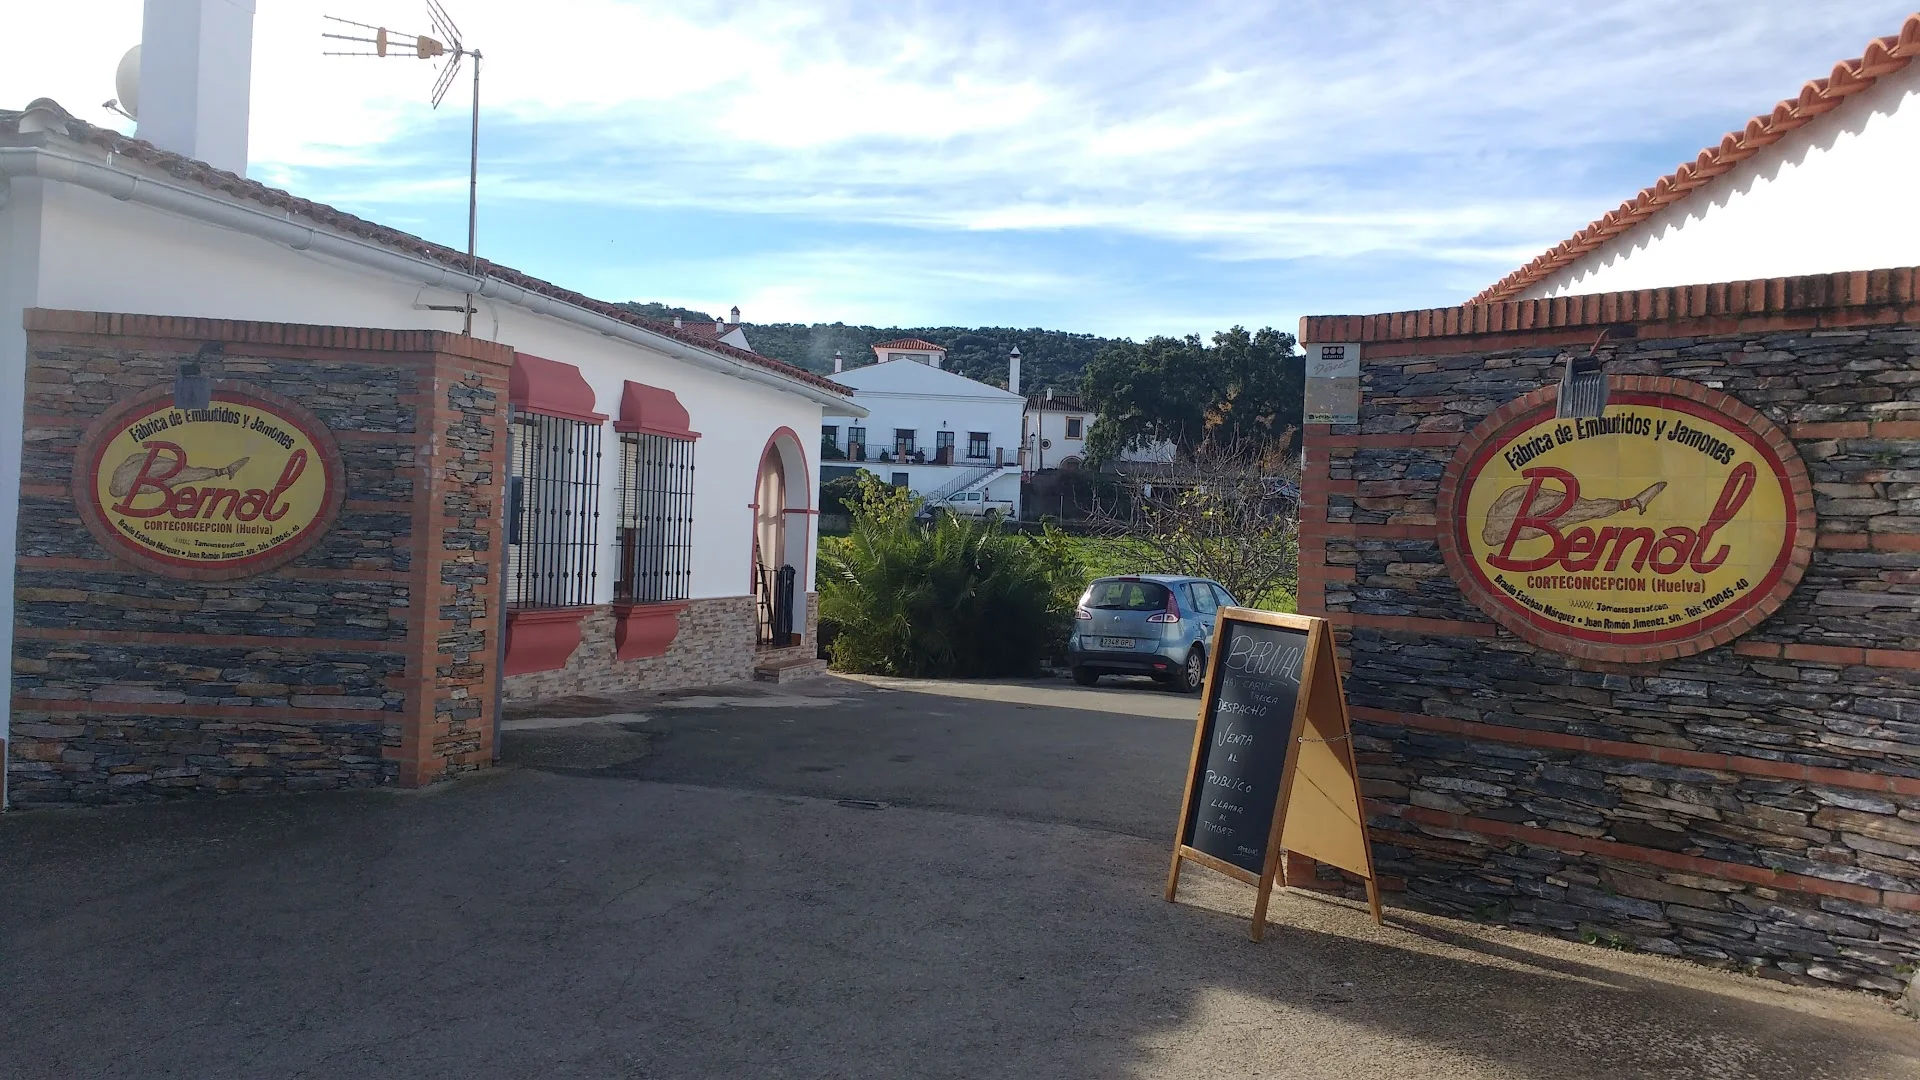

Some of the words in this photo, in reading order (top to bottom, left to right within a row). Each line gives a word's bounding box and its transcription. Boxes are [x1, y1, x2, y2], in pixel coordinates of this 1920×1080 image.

[128, 418, 168, 443] Fábrica
[168, 411, 183, 427] de
[184, 407, 240, 424] Embutidos
[242, 414, 250, 429] y
[250, 416, 295, 450] Jamones
[1503, 436, 1555, 471] Fábrica
[1554, 423, 1573, 445] de
[1575, 412, 1651, 440] Embutidos
[1654, 420, 1667, 441] y
[1667, 420, 1735, 465] Jamones
[111, 441, 308, 522] Bernal
[144, 520, 232, 533] CORTECONCEPCION
[236, 524, 273, 535] (Huelva)
[1486, 461, 1757, 575] Bernal
[134, 531, 156, 547] Esteban
[186, 550, 200, 559] Juan
[1527, 575, 1646, 592] CORTECONCEPCION
[1652, 578, 1705, 594] (Huelva)
[1494, 574, 1517, 596] Braulio
[1515, 590, 1543, 612] Esteban
[1543, 604, 1576, 623] Márquez
[1584, 617, 1602, 628] Juan
[1603, 618, 1631, 629] Ramón
[1224, 635, 1306, 684] BERNAL
[1243, 680, 1275, 691] CARNE
[1215, 698, 1267, 716] DESPACHO
[1218, 722, 1253, 747] VENTA
[1227, 753, 1238, 762] AL
[1210, 798, 1244, 814] LLAMAR
[1204, 820, 1235, 837] TIMBRE
